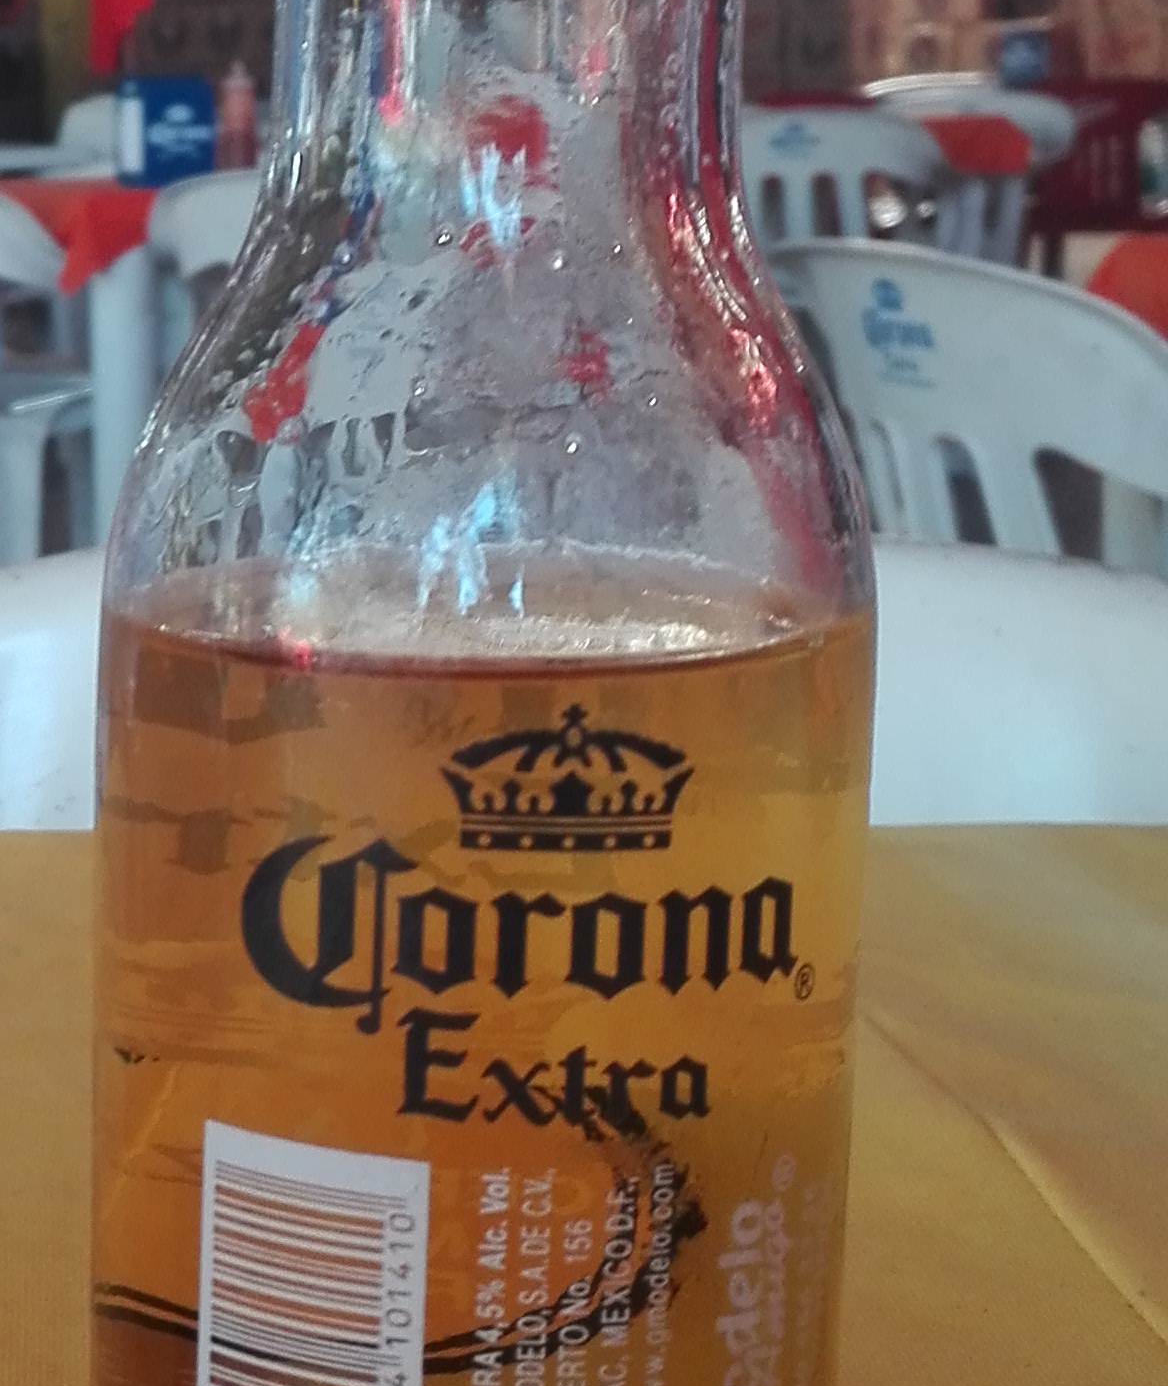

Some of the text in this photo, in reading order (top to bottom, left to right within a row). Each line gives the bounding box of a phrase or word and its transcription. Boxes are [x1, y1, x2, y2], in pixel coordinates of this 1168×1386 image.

[241, 834, 798, 1035] Corona
[395, 1006, 712, 1128] Extra
[478, 1219, 509, 1270] Alc.
[479, 1167, 510, 1215] Vol.
[563, 1219, 593, 1264] 156
[385, 1213, 416, 1345] 101410
[601, 1238, 633, 1348] MEXICO
